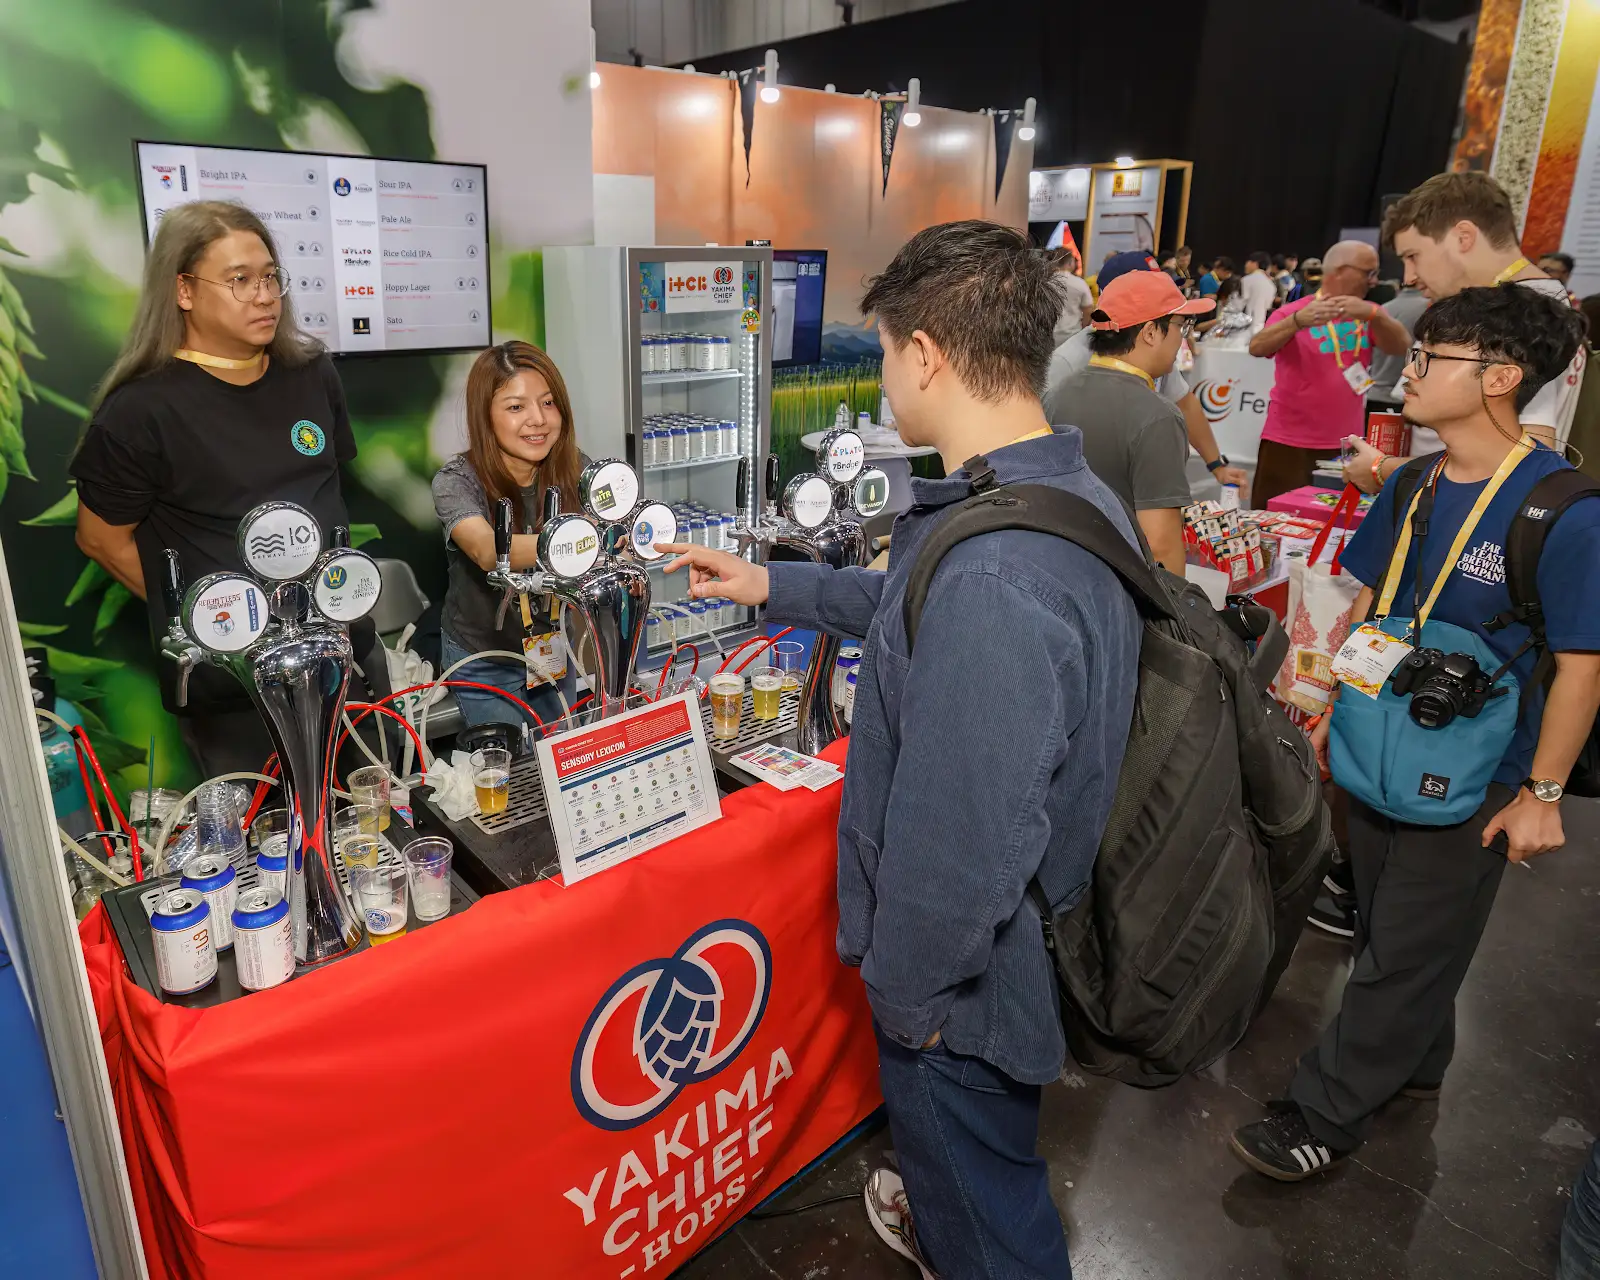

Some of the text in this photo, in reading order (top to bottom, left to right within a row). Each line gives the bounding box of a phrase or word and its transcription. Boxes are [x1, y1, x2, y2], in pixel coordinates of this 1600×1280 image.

[200, 169, 228, 181] Bright
[231, 171, 247, 181] IPA
[379, 180, 396, 188] Sour
[398, 181, 412, 190] IPA
[273, 210, 302, 220] Wheat
[381, 215, 397, 223] Pale
[399, 216, 412, 224] Ale
[383, 249, 432, 258] Rice Cold IPA
[385, 283, 430, 292] Hoppy Lager
[386, 316, 403, 324] Sato
[1482, 540, 1501, 555] FAR
[1472, 546, 1505, 565] YEAST
[1462, 552, 1506, 575] BREWING
[1456, 560, 1507, 584] COMPANY
[1445, 666, 1463, 678] Canon
[561, 751, 594, 771] SENSORY
[596, 741, 626, 758] LEXICON
[563, 1047, 794, 1226] YAKIMA
[602, 1104, 774, 1256] CHIEF
